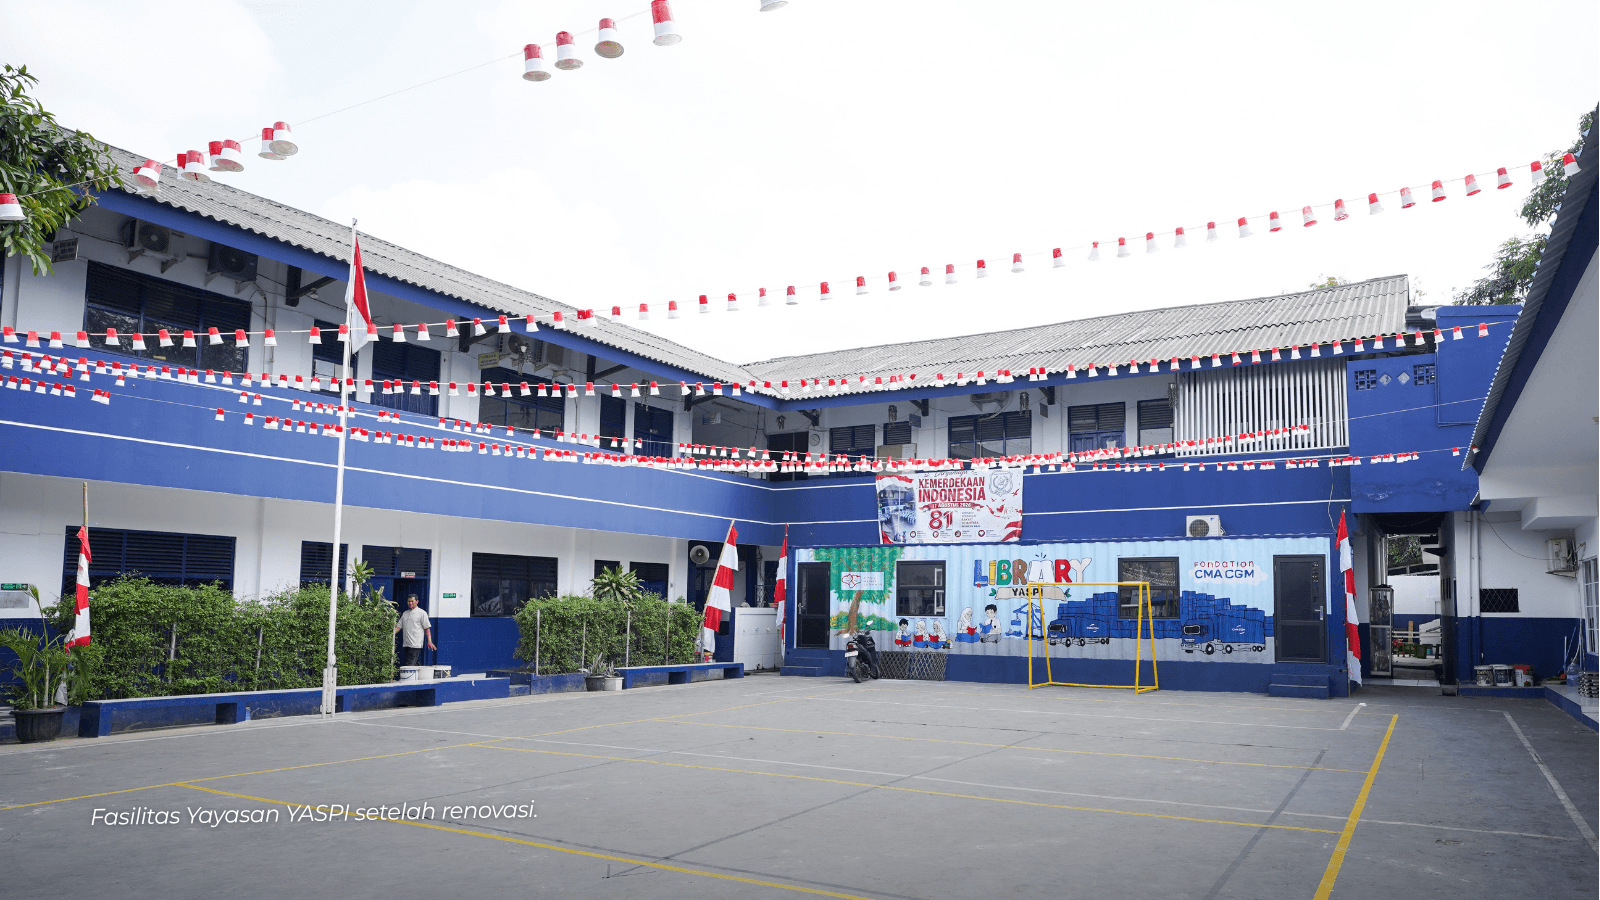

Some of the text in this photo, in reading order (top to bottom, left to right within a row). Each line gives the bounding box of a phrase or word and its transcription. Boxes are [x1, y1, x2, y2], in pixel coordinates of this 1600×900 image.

[918, 476, 985, 488] KEMERDEKAAN
[918, 487, 986, 502] INDONESIA
[929, 510, 953, 530] 81
[973, 558, 1093, 587] LIBRARY
[1194, 569, 1255, 579] CMA CGM
